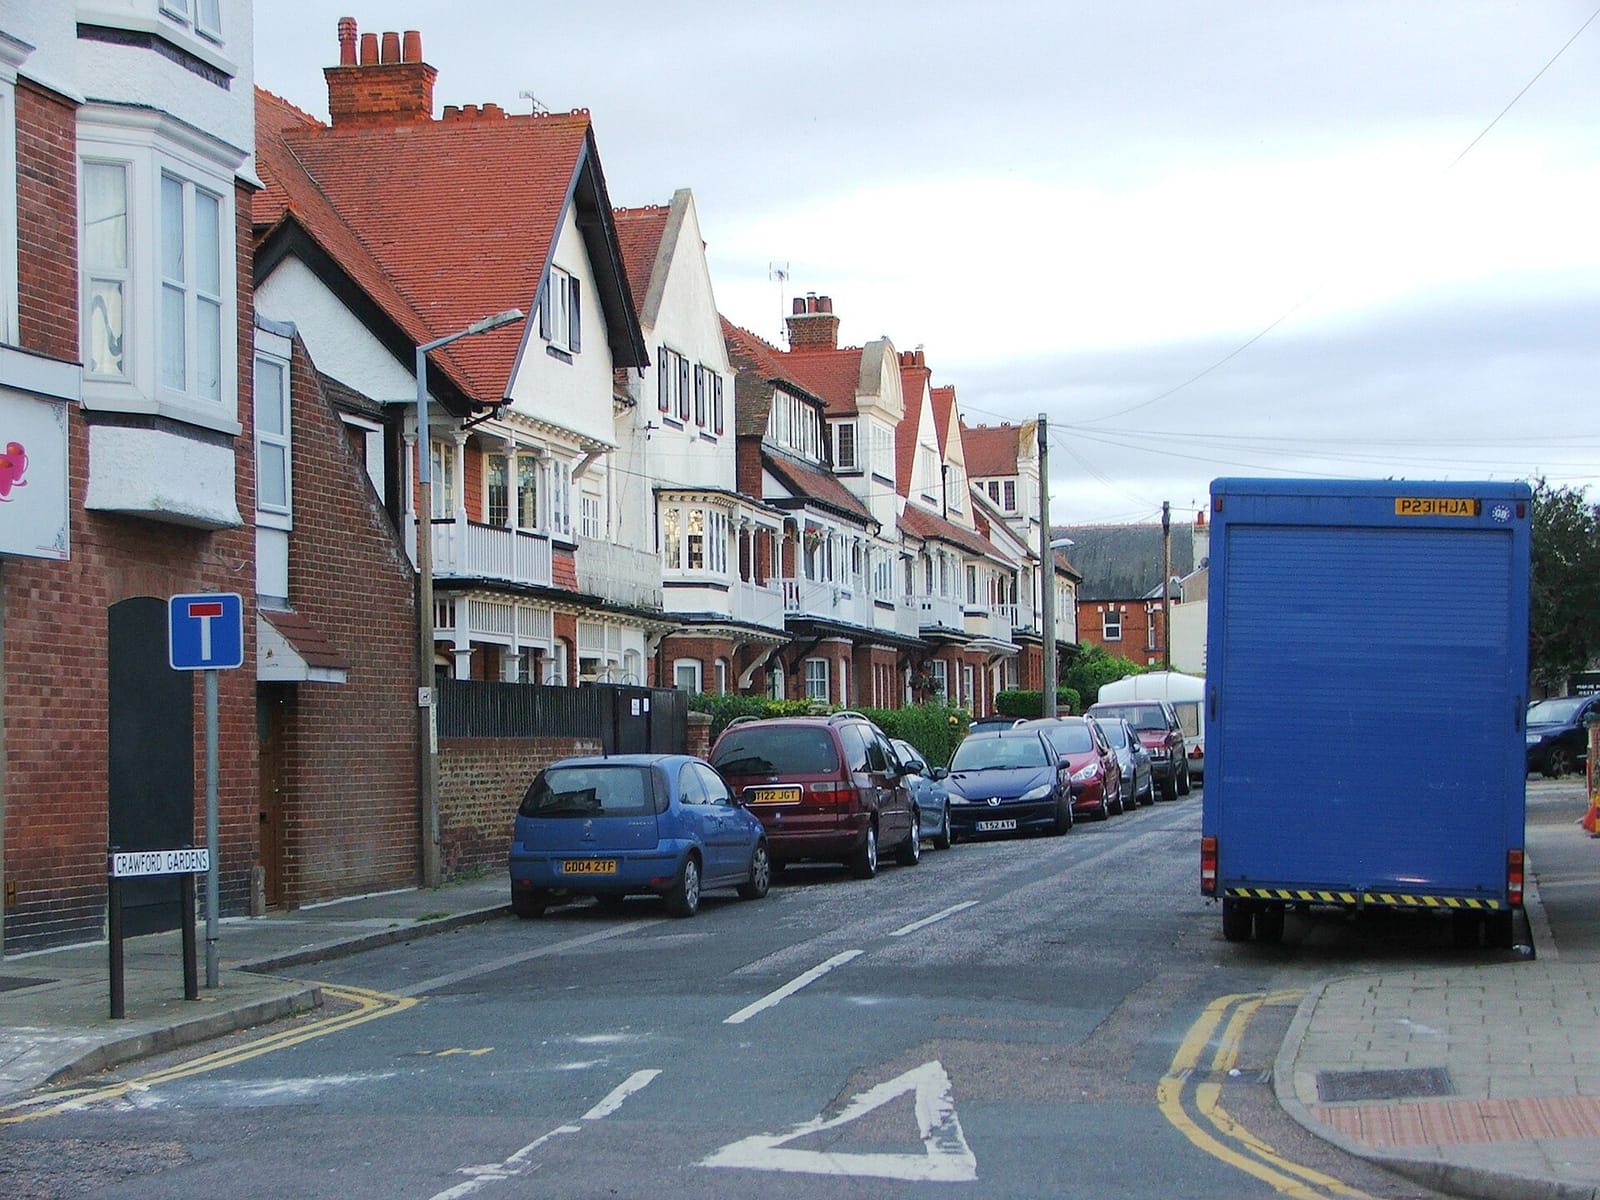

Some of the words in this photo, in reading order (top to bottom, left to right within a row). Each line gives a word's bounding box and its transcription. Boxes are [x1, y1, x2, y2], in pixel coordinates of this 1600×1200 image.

[1401, 500, 1436, 513] P231
[1438, 500, 1468, 514] HJA
[778, 790, 796, 800] JGT
[116, 853, 162, 874] CRAWFORD
[167, 850, 208, 870] GARDENS
